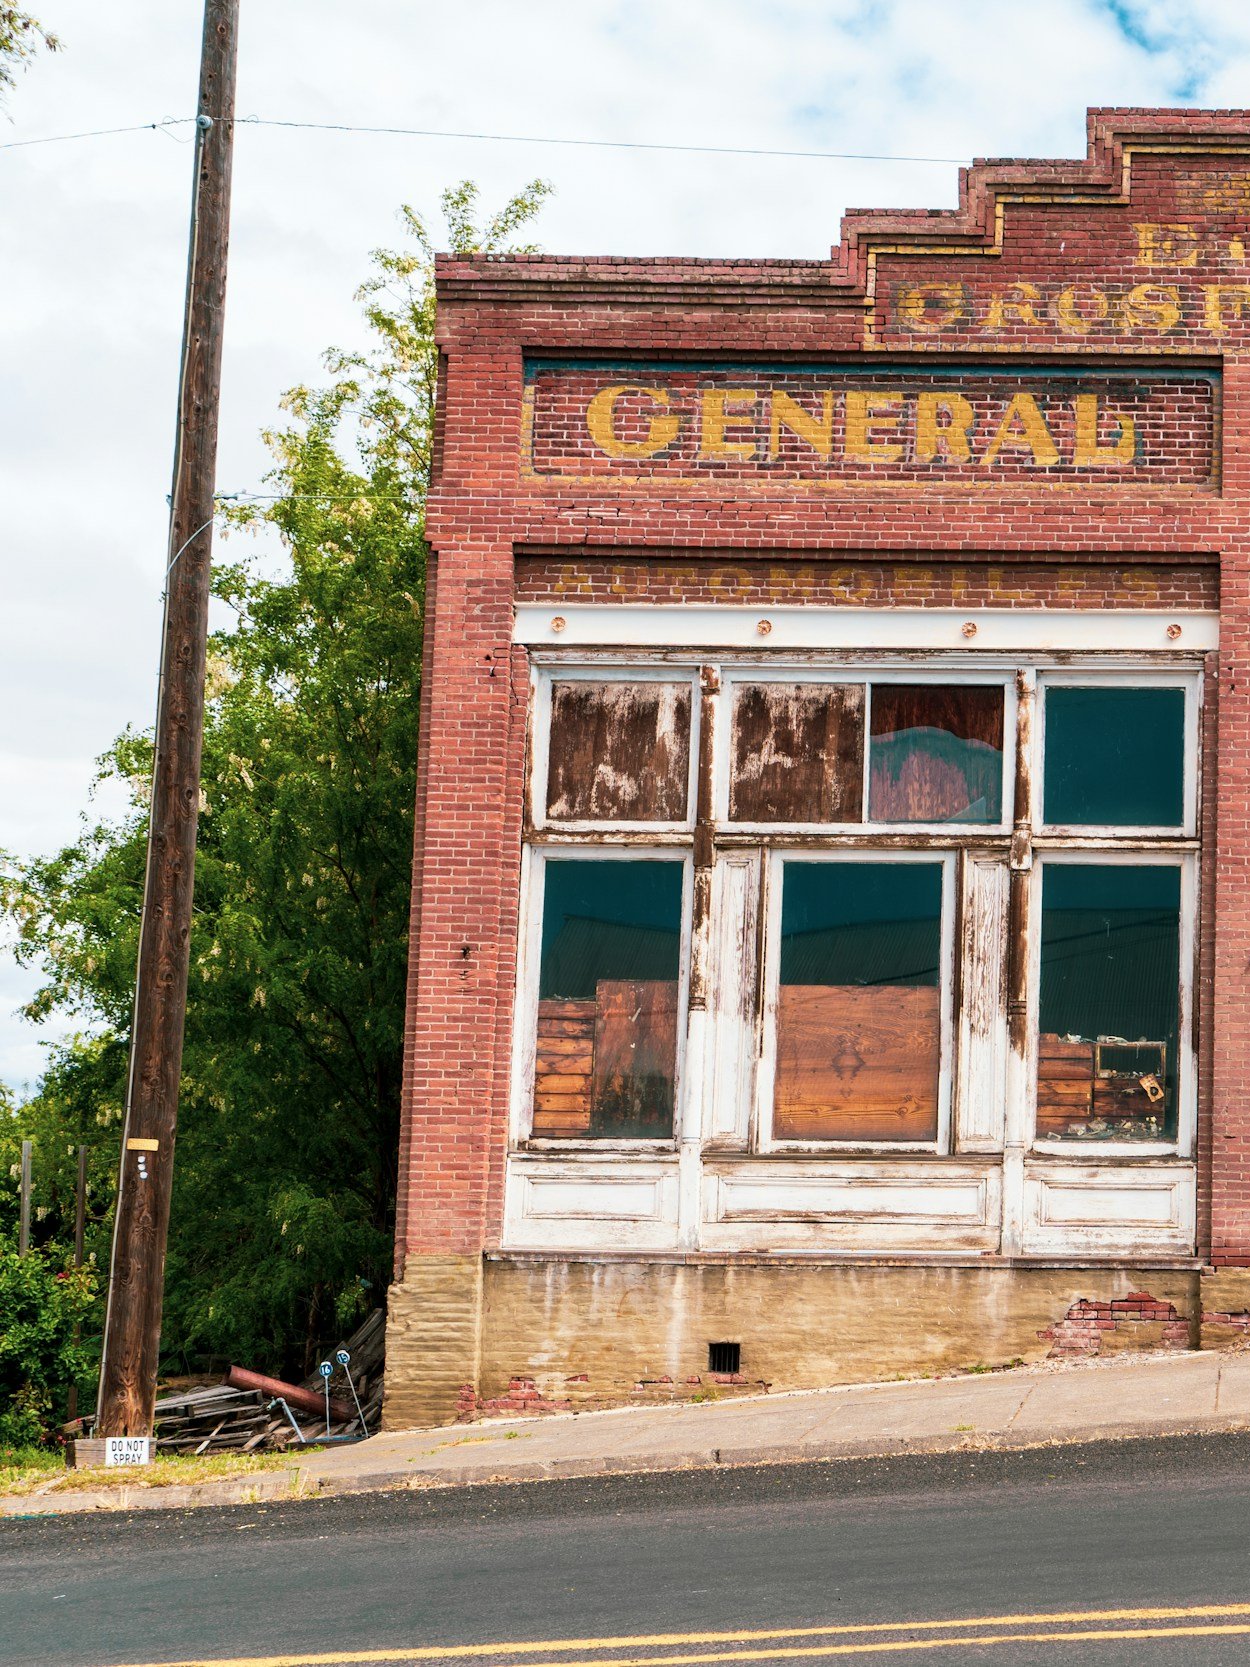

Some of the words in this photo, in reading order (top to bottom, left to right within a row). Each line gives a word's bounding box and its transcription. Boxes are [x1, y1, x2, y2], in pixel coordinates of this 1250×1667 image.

[586, 384, 1137, 466] GENERAL
[111, 1440, 123, 1451] DO
[126, 1440, 144, 1451] NOT
[113, 1453, 142, 1464] SPRAY
